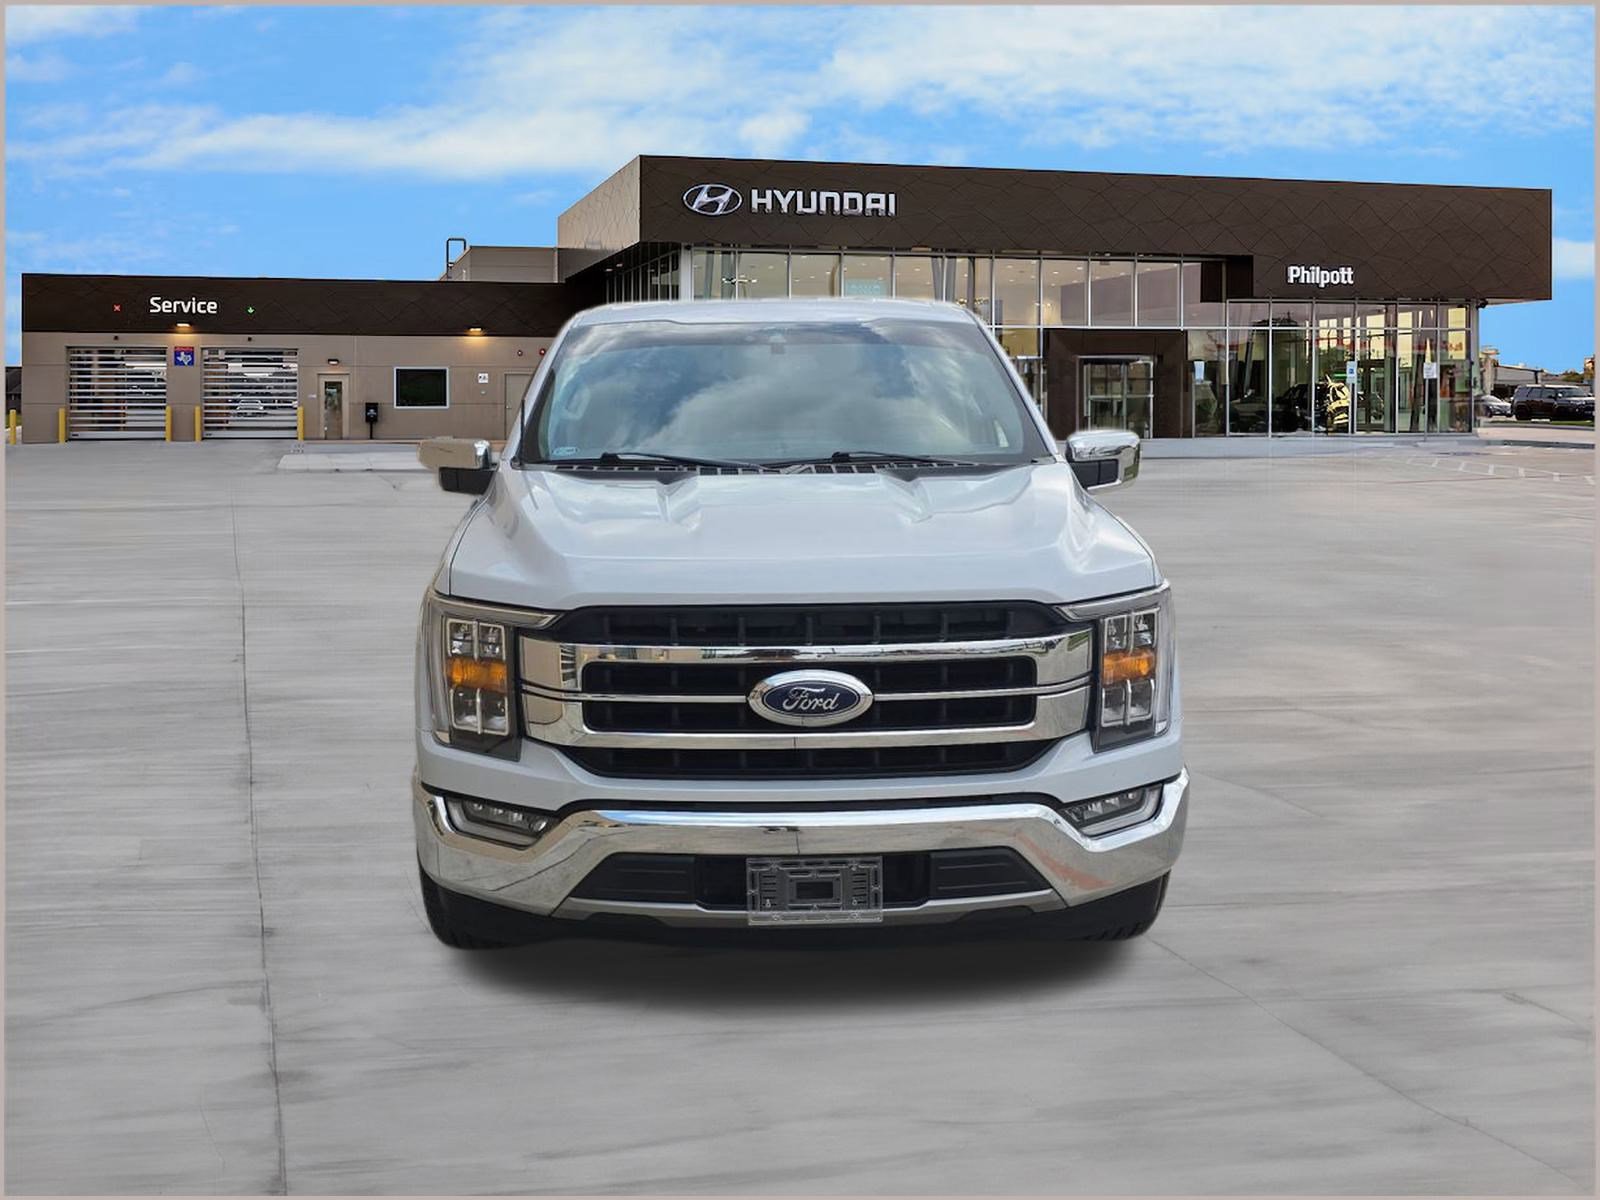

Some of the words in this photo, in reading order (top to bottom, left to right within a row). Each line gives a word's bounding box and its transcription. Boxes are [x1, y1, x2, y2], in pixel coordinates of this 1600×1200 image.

[751, 188, 897, 216] HYUNDAI
[1287, 265, 1355, 288] Philpott
[149, 296, 218, 314] Service
[782, 686, 841, 711] Ford
